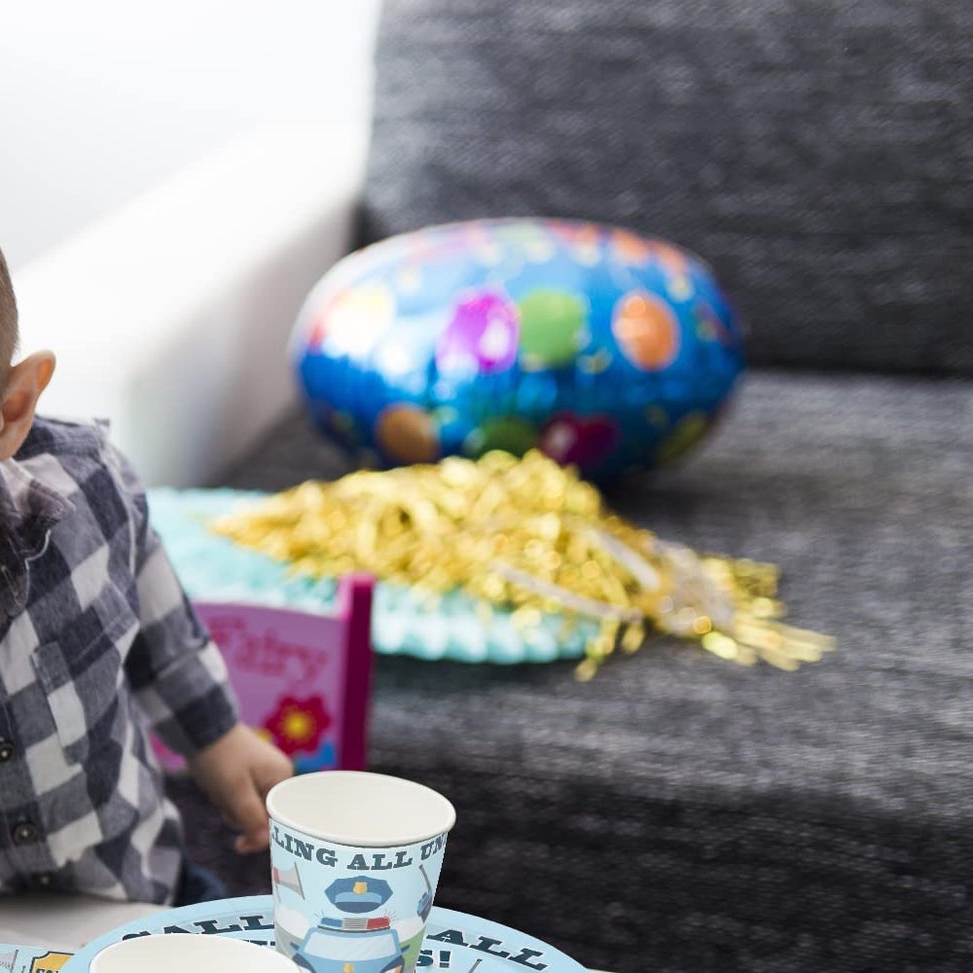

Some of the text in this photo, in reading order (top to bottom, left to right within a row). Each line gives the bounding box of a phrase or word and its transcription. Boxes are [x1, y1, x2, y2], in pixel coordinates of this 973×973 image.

[271, 826, 338, 867] LING
[347, 851, 413, 870] ALL
[425, 929, 548, 971] ALL
